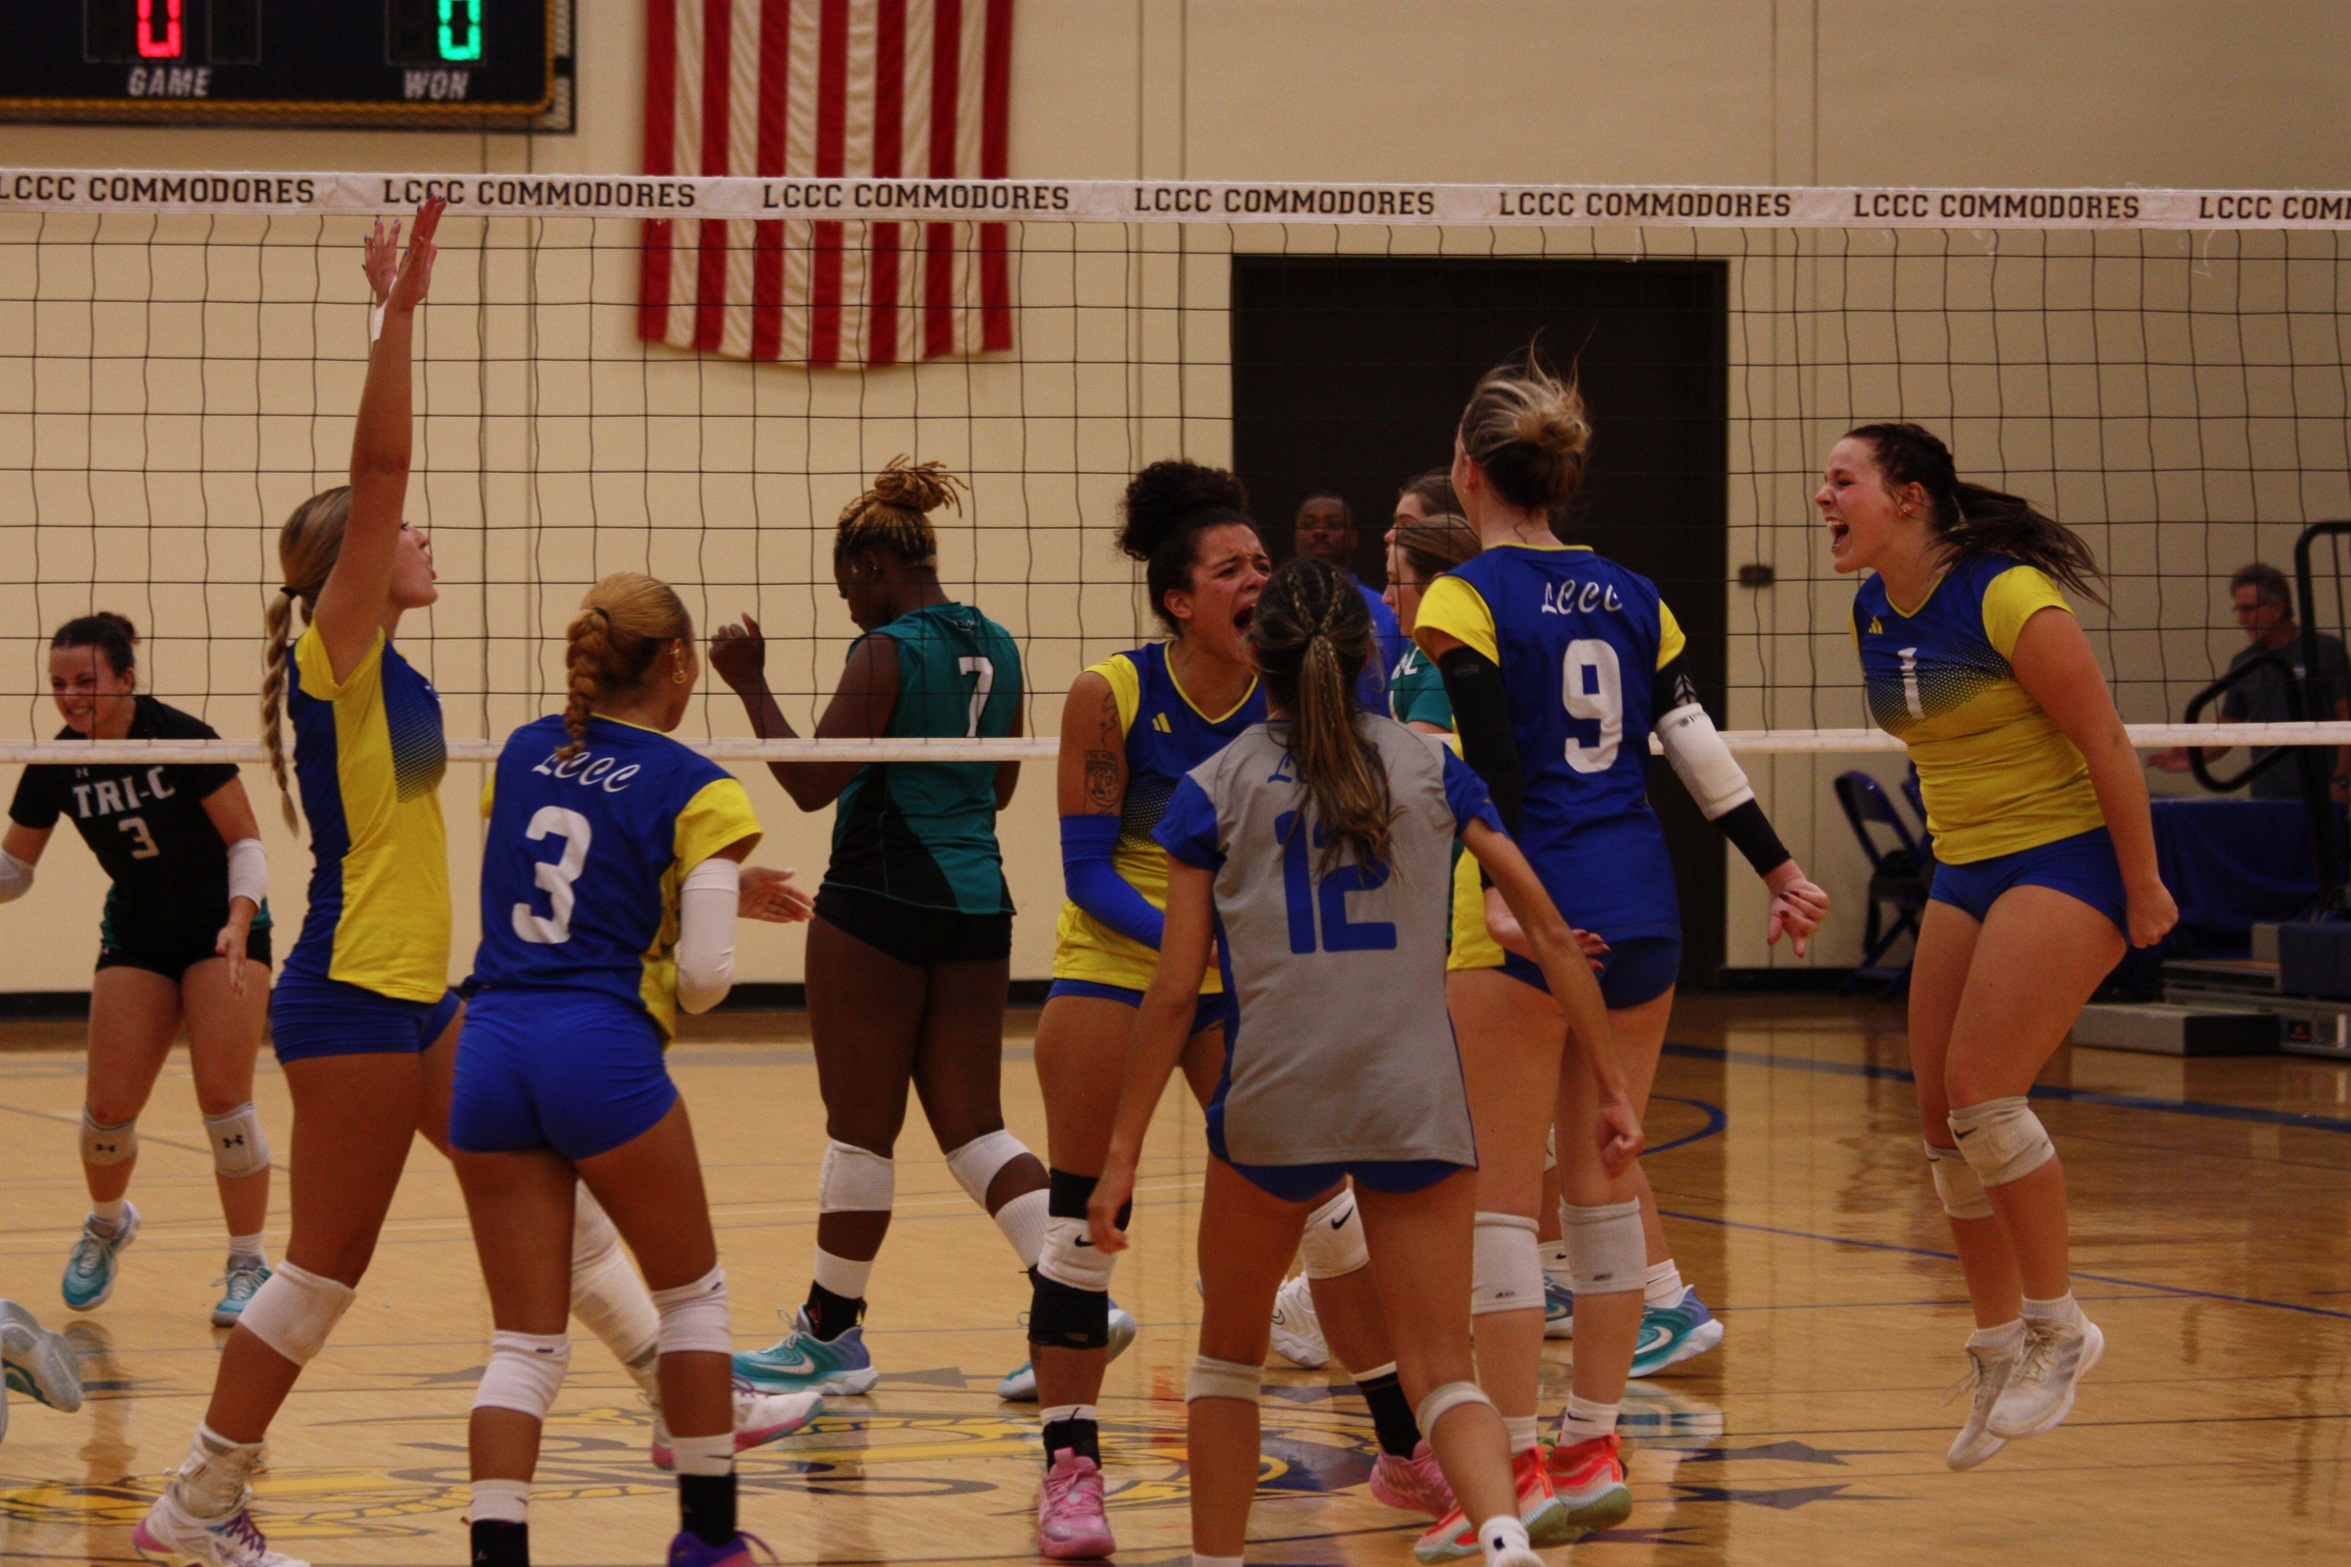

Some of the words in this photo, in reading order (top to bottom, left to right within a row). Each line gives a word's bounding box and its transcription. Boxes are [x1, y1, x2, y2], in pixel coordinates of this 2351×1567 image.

[438, 0, 481, 60] 0
[128, 66, 212, 96] GAME
[403, 70, 469, 99] WON
[89, 177, 315, 203] COMMODORES
[384, 179, 464, 204] LCCC
[478, 180, 696, 207] COMMODORES
[763, 184, 842, 208] LCCC
[855, 184, 1069, 210] COMMODORES
[1135, 188, 1212, 212] LCCC
[1224, 189, 1434, 215] COMMODORES
[1499, 191, 1574, 216] LCCC
[1586, 192, 1790, 218] COMMODORES
[1854, 194, 1928, 217] LCCC
[1940, 194, 2139, 219] COMMODORES
[2200, 196, 2271, 219] LCCC
[2282, 197, 2351, 219] COM
[958, 656, 993, 737] 7
[1897, 647, 1927, 719] 1
[1563, 639, 1623, 774] 9
[531, 751, 641, 792] LCCC
[72, 766, 175, 818] TRI-C
[118, 816, 159, 859] 3
[512, 805, 592, 944] 3
[1274, 810, 1397, 954] 12
